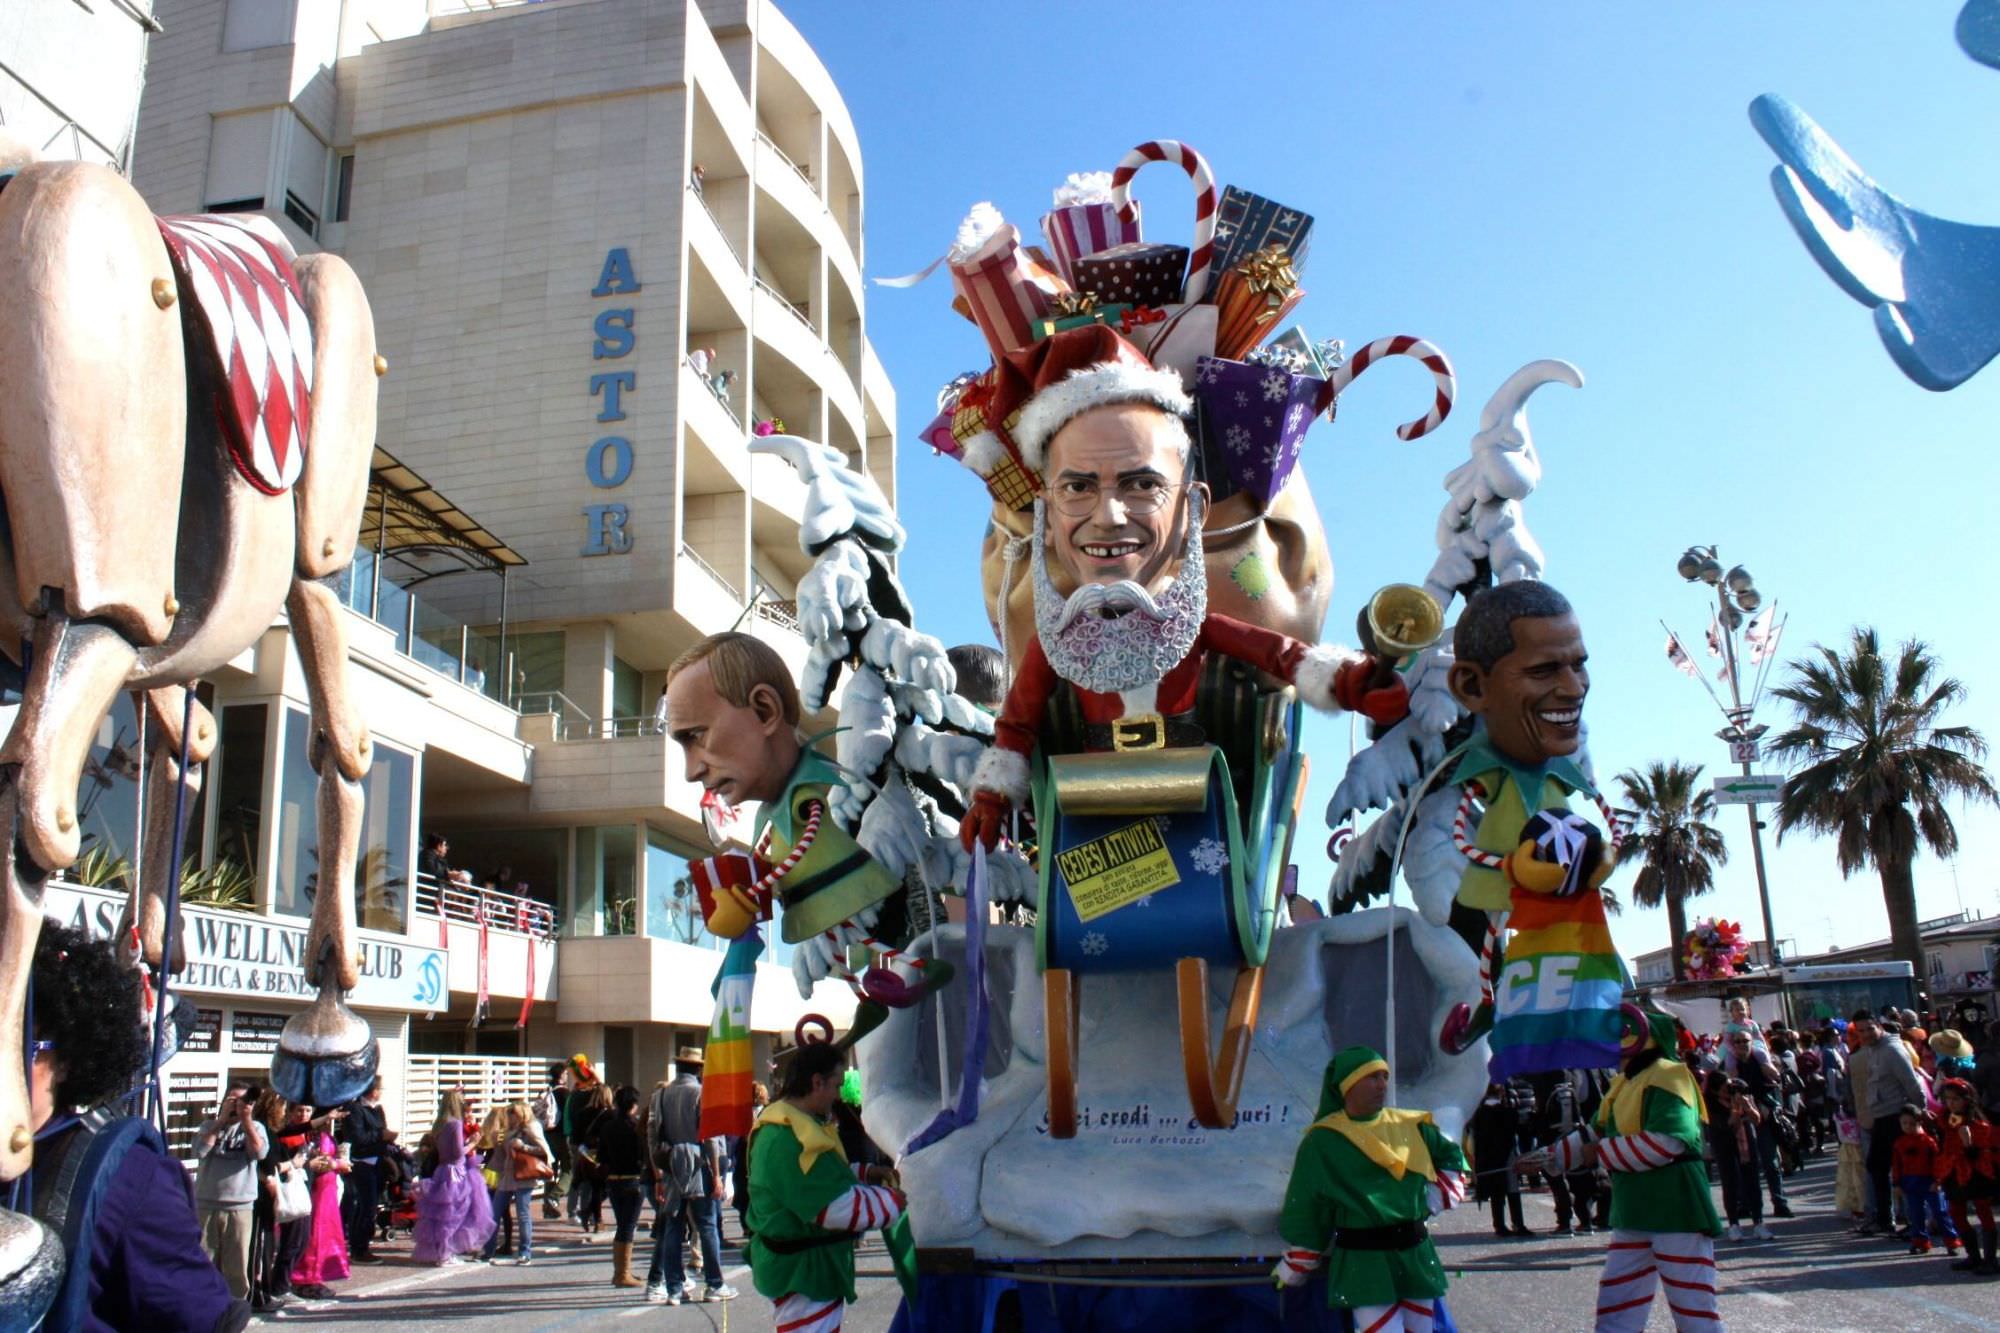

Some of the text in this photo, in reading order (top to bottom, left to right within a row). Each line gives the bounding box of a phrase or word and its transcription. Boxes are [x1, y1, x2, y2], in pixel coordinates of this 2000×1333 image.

[579, 247, 642, 557] ASTOR
[1736, 743, 1755, 760] 22
[1060, 841, 1108, 883] CEDESI
[358, 942, 402, 980] LUB
[248, 968, 260, 990] &
[1100, 1105, 1148, 1126] credi
[1112, 1136, 1142, 1145] Luca
